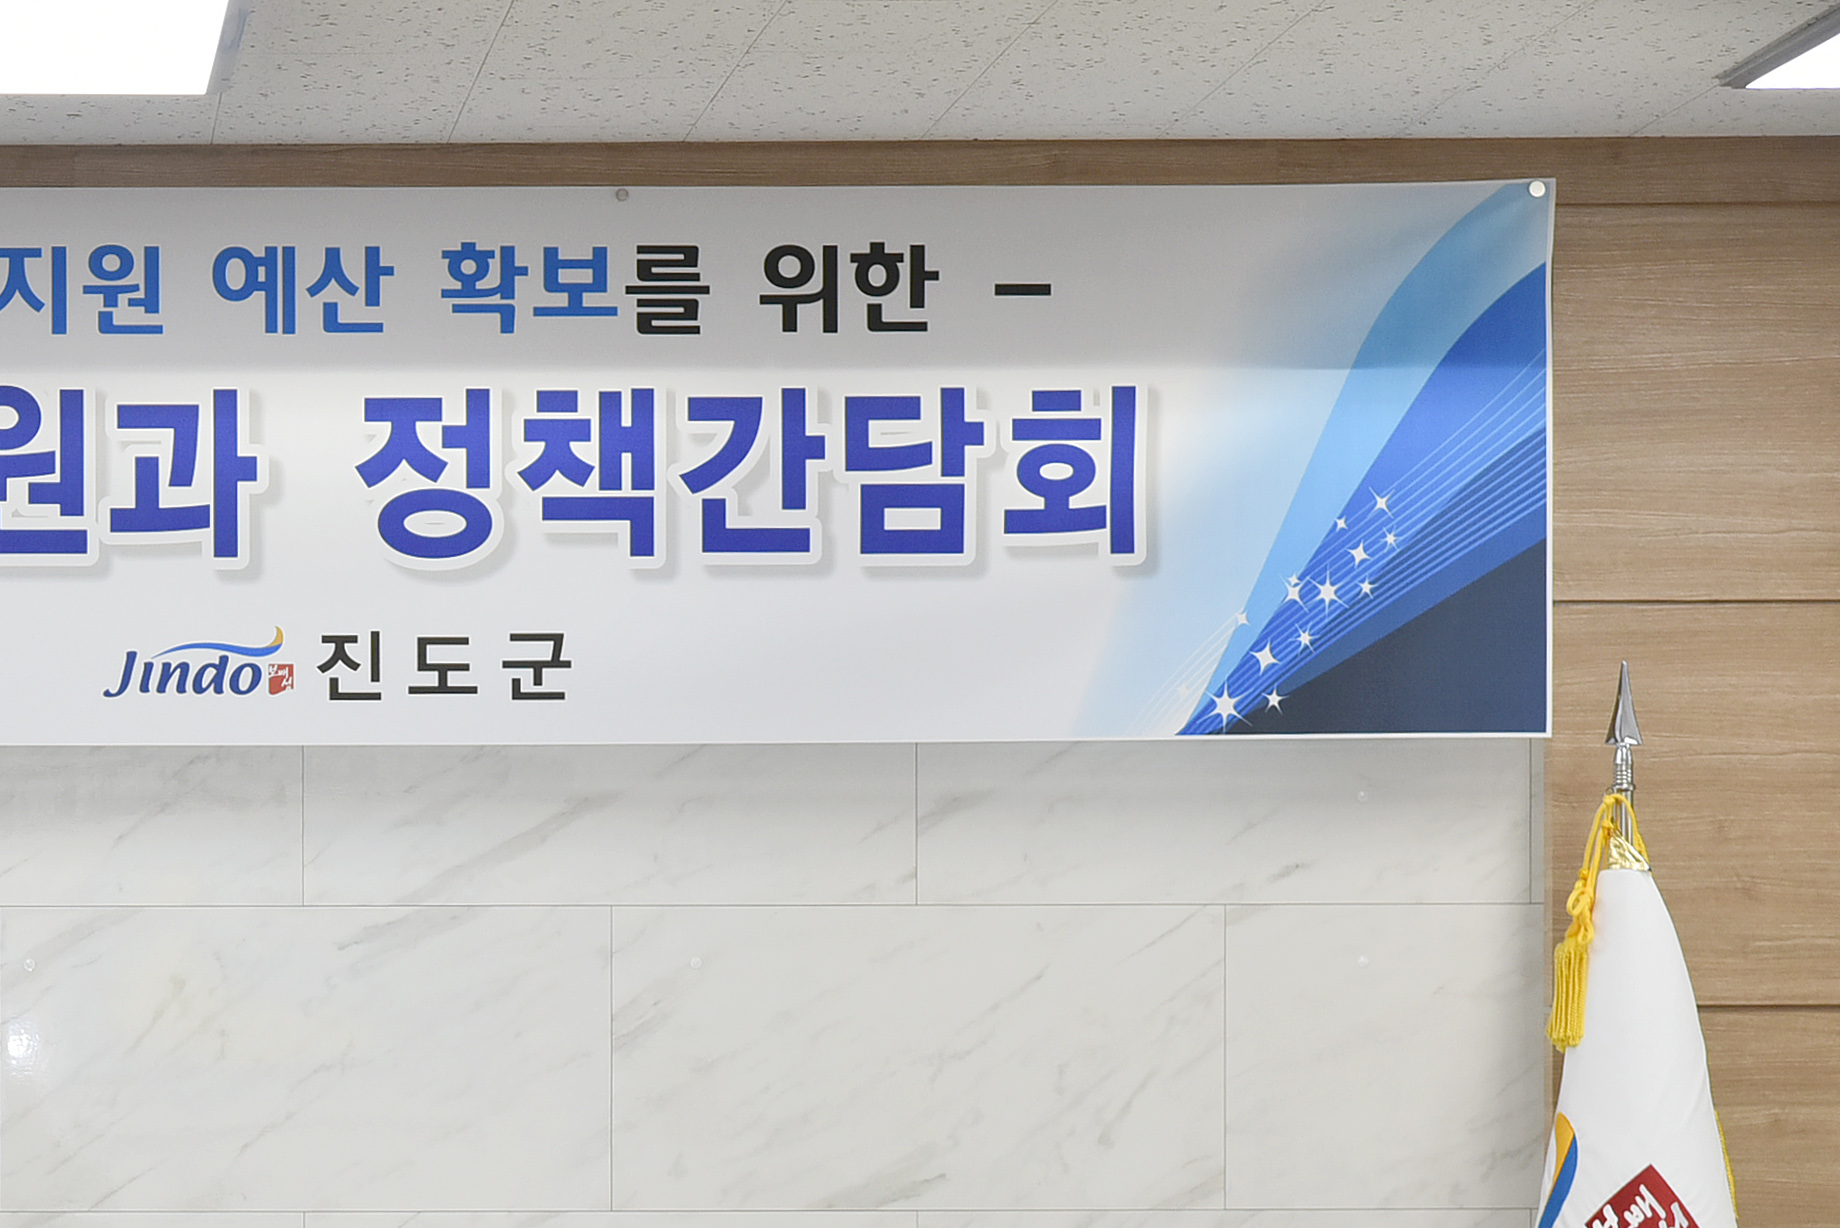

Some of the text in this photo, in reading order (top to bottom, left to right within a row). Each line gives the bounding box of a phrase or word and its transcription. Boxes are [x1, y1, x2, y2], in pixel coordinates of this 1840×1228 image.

[211, 244, 395, 334] 예산
[440, 241, 711, 335] 확보를
[759, 242, 940, 333] 위한
[354, 385, 1137, 560] 정책간담회
[103, 647, 263, 699] Jindo
[316, 630, 573, 702] 진도군
